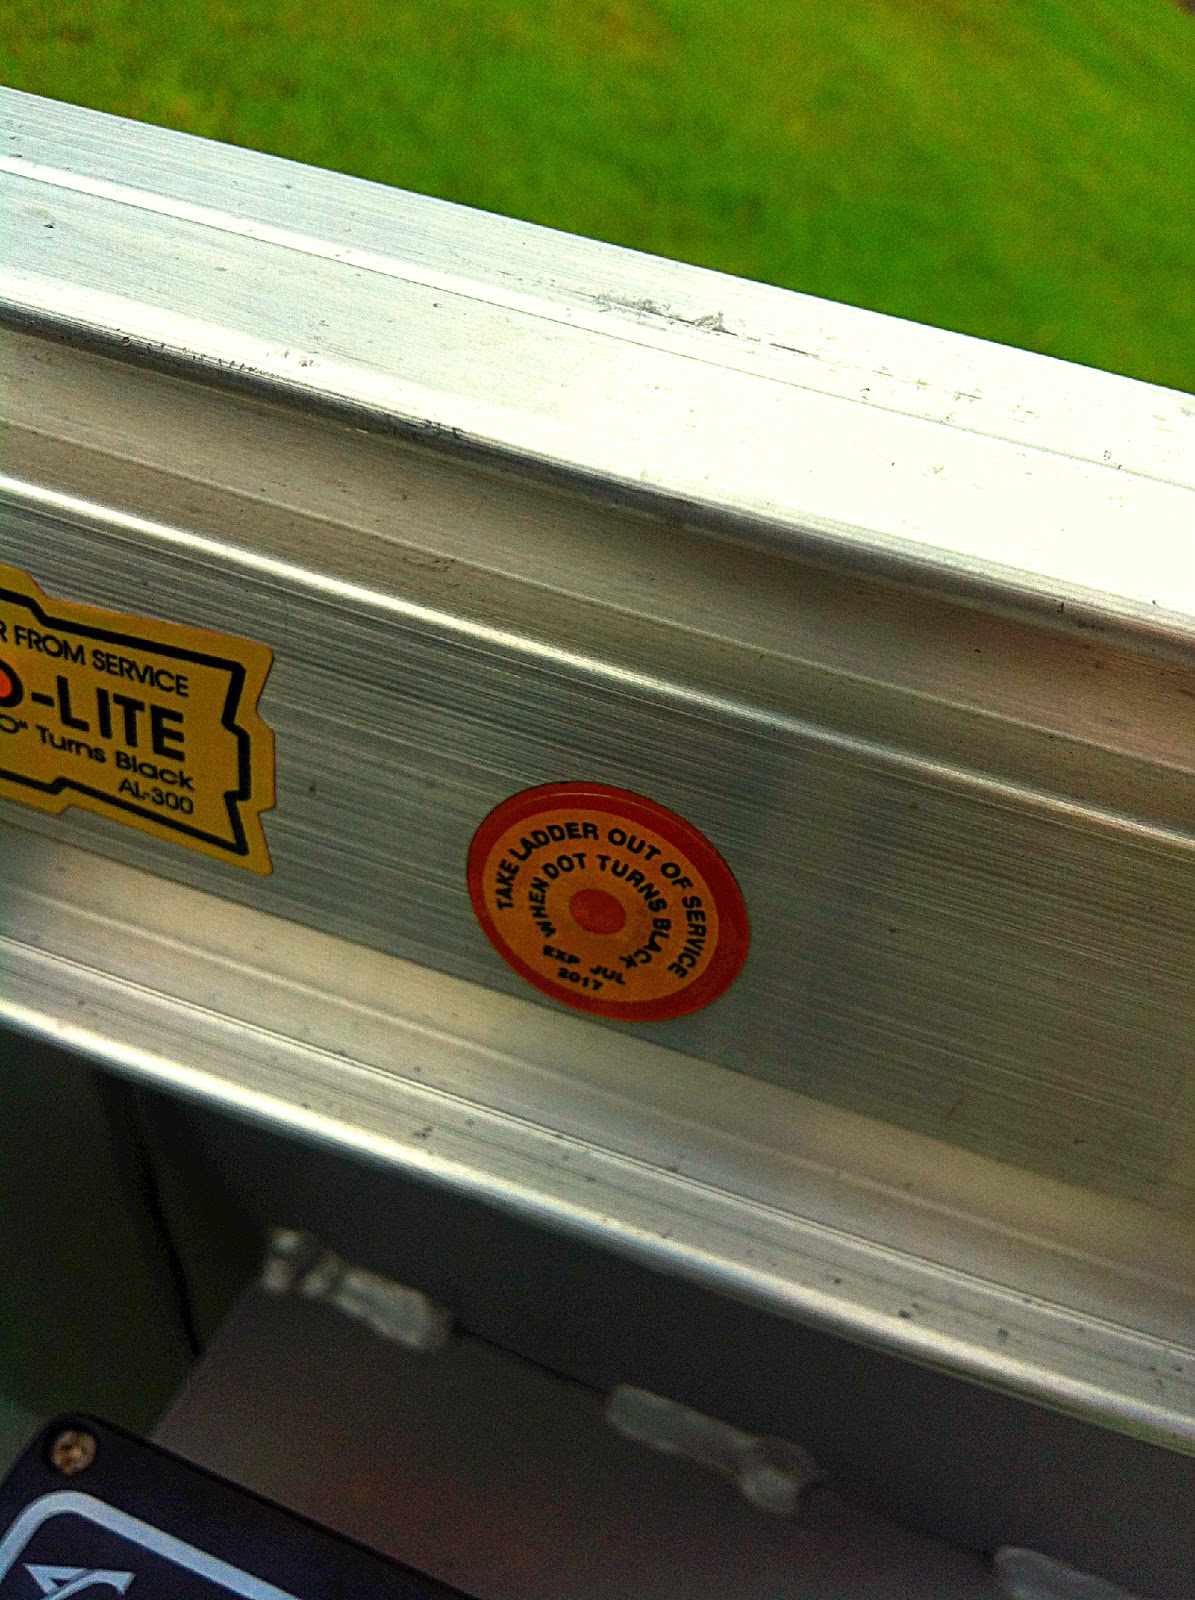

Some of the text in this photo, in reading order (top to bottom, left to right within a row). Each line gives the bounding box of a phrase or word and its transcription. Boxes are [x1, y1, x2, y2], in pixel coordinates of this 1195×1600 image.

[14, 625, 86, 666] FROM
[92, 649, 189, 698] SERVICE
[36, 724, 106, 763] Turns
[115, 750, 195, 793] Black
[118, 777, 195, 815] AL-300
[496, 822, 707, 978] TAKE LADDER OUT OF SERVICE
[528, 853, 672, 969] WHEN DOT TURNS BLACK
[542, 945, 626, 985] EXP JUL
